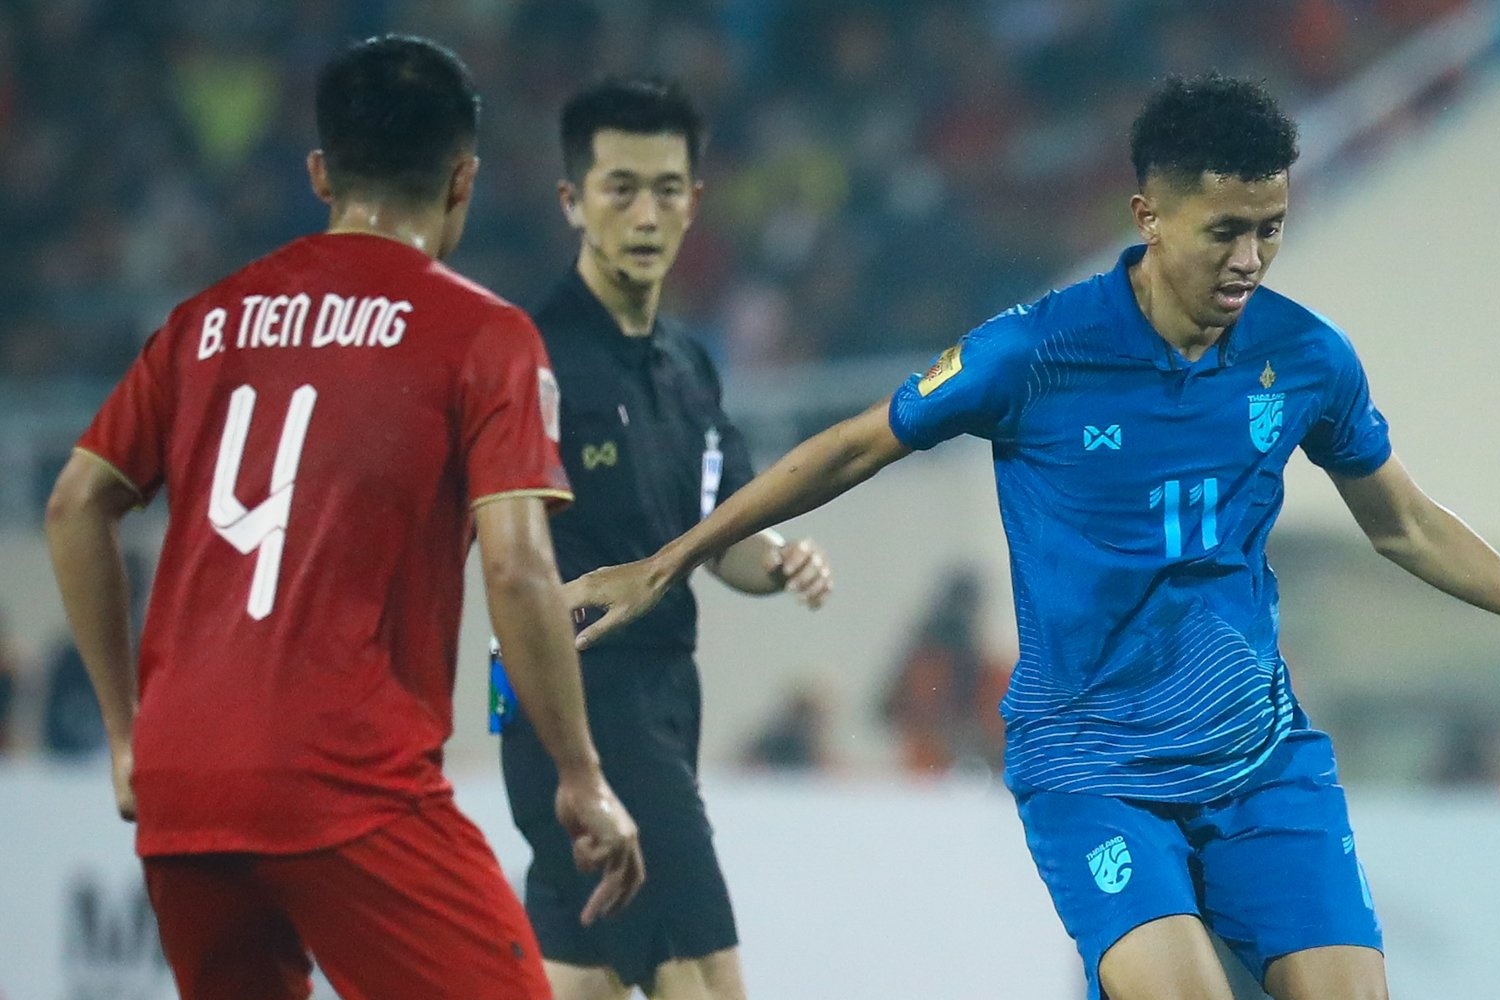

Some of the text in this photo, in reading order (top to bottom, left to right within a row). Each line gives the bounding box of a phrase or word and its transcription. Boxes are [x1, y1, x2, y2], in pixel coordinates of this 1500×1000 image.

[197, 292, 414, 360] B. TIEN DUNG
[207, 383, 318, 622] 4
[1149, 477, 1220, 559] 11
[1085, 835, 1124, 861] THAILAND
